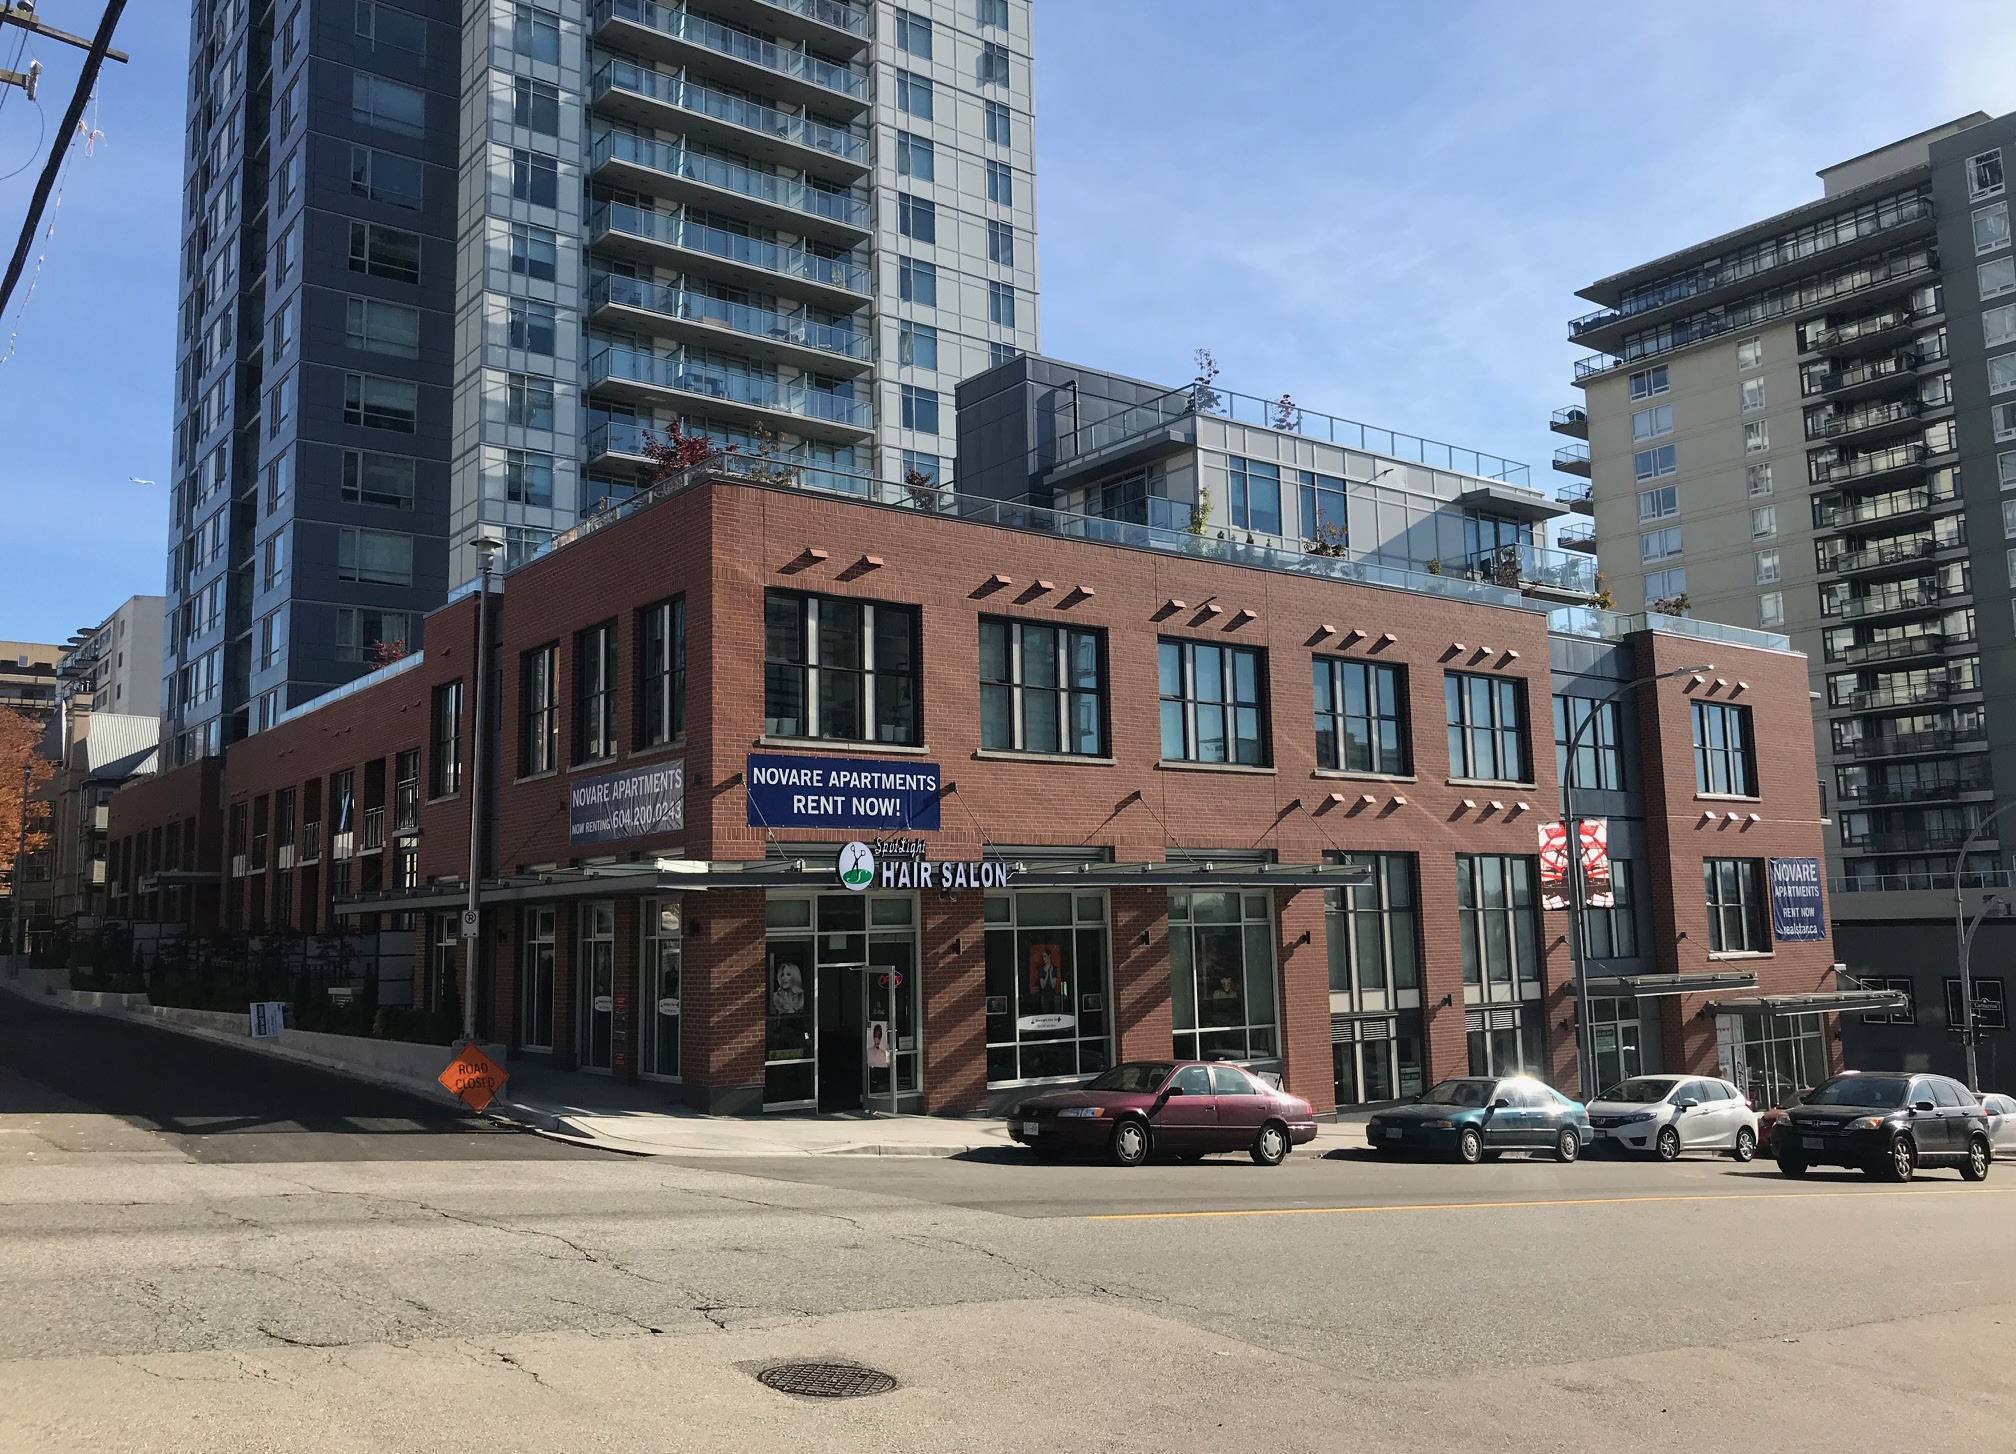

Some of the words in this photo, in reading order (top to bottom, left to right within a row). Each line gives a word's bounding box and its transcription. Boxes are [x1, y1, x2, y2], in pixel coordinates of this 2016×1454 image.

[572, 783, 610, 808] NOVARE
[612, 768, 682, 801] APARTMENTS
[753, 767, 823, 787] NOVARE
[828, 771, 936, 791] APARTMENTS
[793, 795, 845, 815] RENT
[852, 798, 900, 817] NOW!
[571, 822, 584, 835] NOW
[585, 818, 610, 833] RENTING
[612, 799, 682, 829] 604.200.0243
[882, 861, 933, 888] HAIR
[941, 862, 1007, 888] SALON
[1773, 864, 1817, 882] NOVARE
[1774, 885, 1819, 898] APARTMENTS
[1783, 907, 1799, 918] RENT
[1801, 907, 1815, 918] NOW
[459, 1063, 488, 1075] ROAD
[456, 1077, 495, 1090] CLOSED
